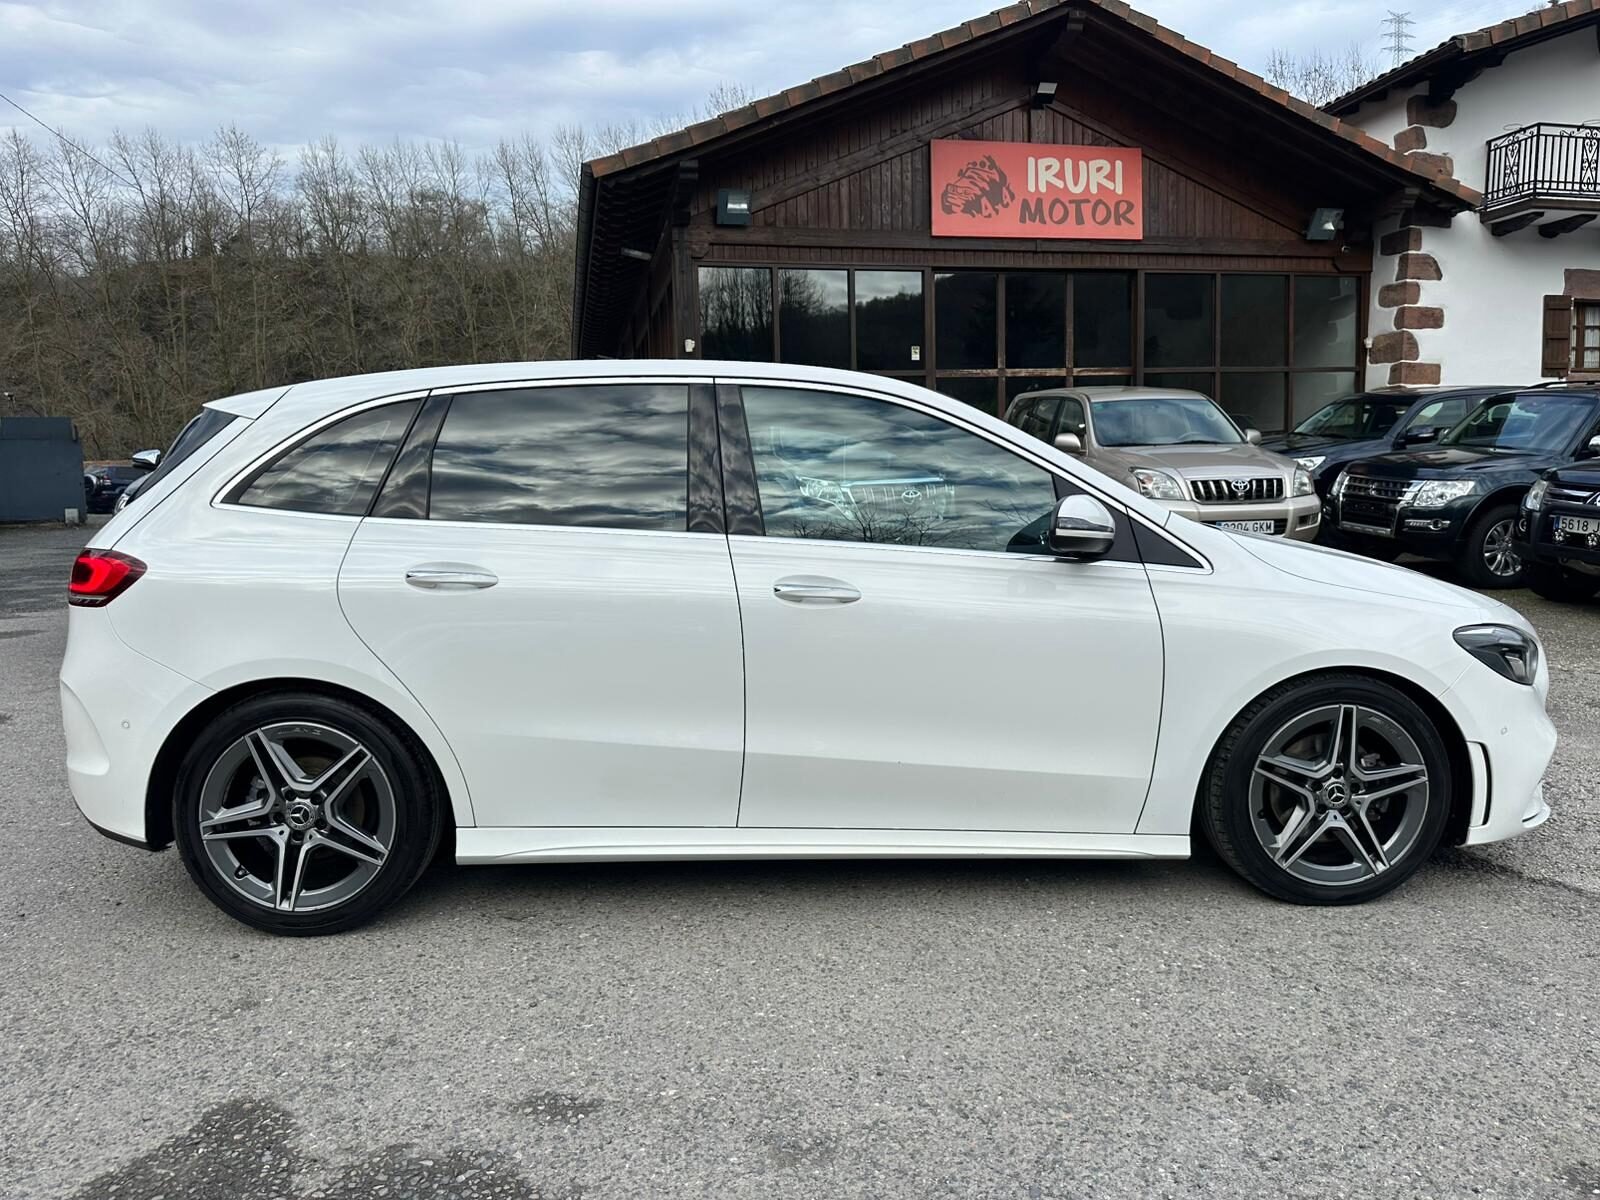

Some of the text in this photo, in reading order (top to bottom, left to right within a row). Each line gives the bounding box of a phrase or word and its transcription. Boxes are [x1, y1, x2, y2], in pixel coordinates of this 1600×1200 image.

[1027, 156, 1123, 195] IRURI
[1019, 197, 1135, 226] MOTOR
[1252, 521, 1272, 532] GKM
[1561, 517, 1589, 532] 5618
